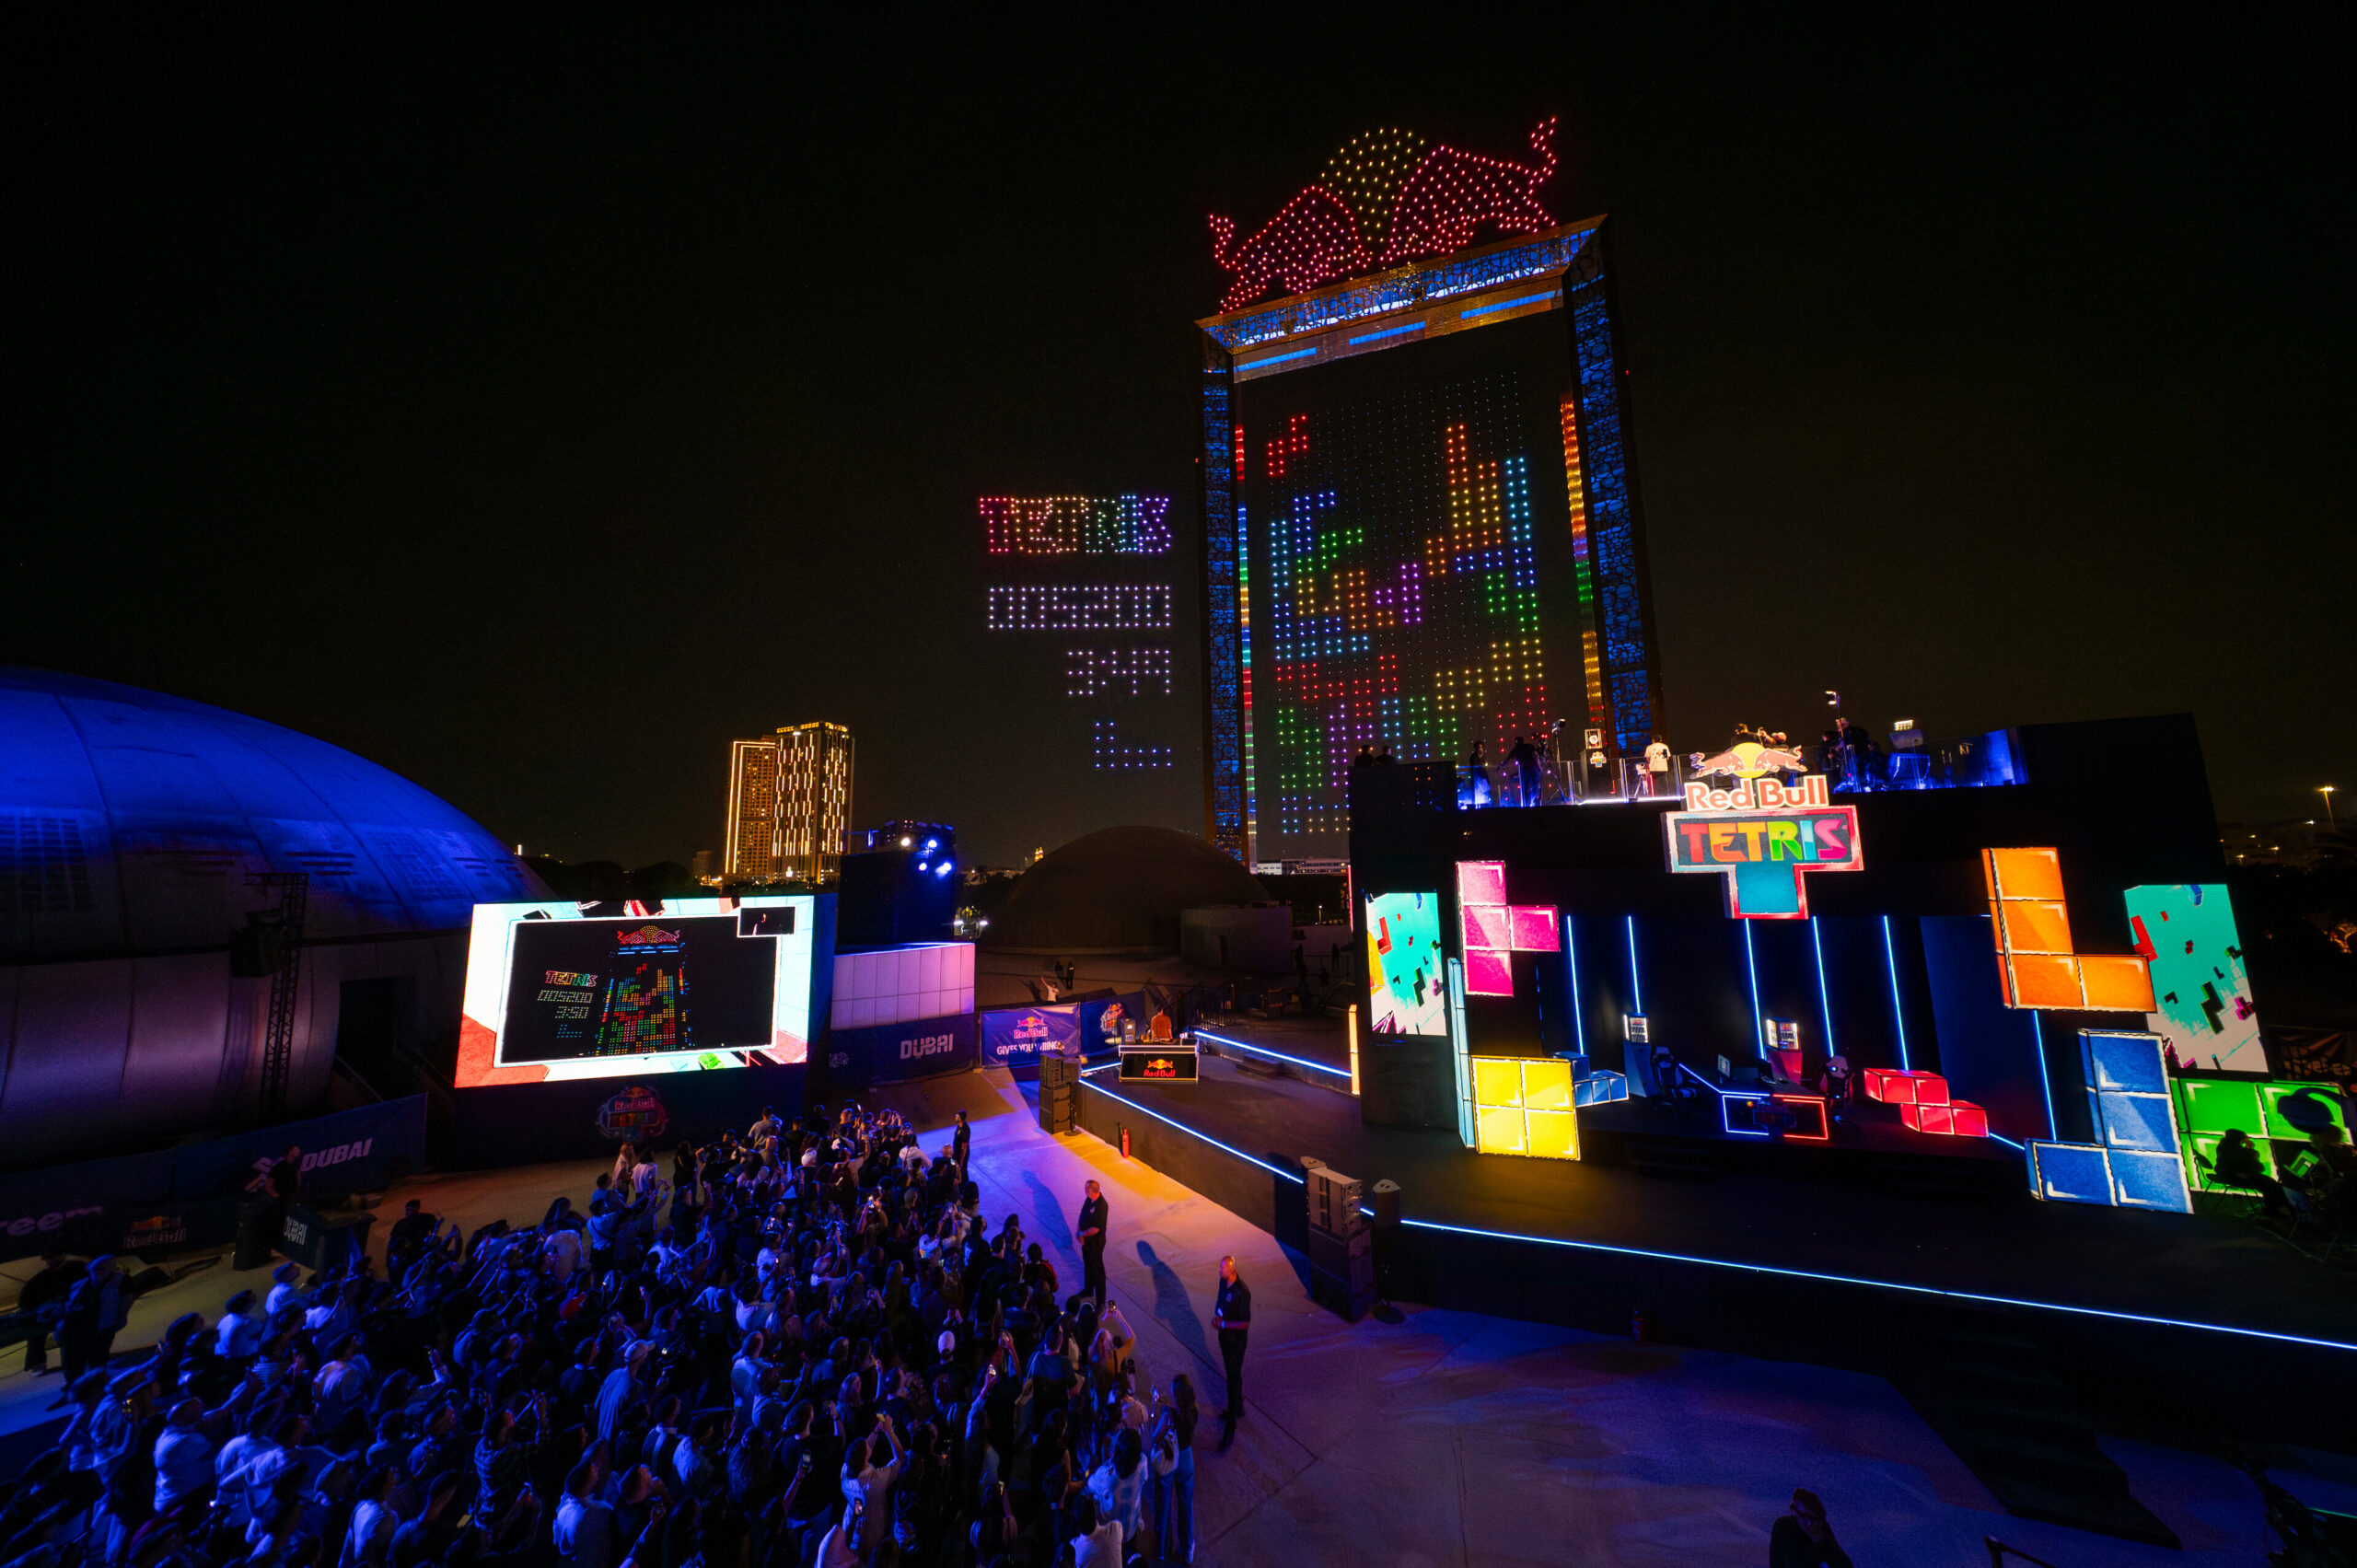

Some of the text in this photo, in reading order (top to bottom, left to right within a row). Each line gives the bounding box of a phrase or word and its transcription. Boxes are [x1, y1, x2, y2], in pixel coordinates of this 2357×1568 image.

[979, 494, 1172, 553] TETRIS
[989, 586, 1171, 628] 005200
[1067, 649, 1171, 695] 3:49
[1684, 775, 1829, 812] Red Bull
[1679, 819, 1848, 863] TETRIS
[545, 970, 598, 987] TETRIS
[537, 990, 594, 1004] 005200
[554, 1005, 589, 1019] 3:50
[900, 1033, 954, 1060] DUBAI
[1014, 1026, 1048, 1039] Red Bull
[996, 1044, 1018, 1056] GIVES
[1019, 1041, 1034, 1054] YOU
[1143, 1069, 1176, 1077] Red Bull
[300, 1138, 374, 1172] DUBAI
[284, 1215, 308, 1246] DUBAI
